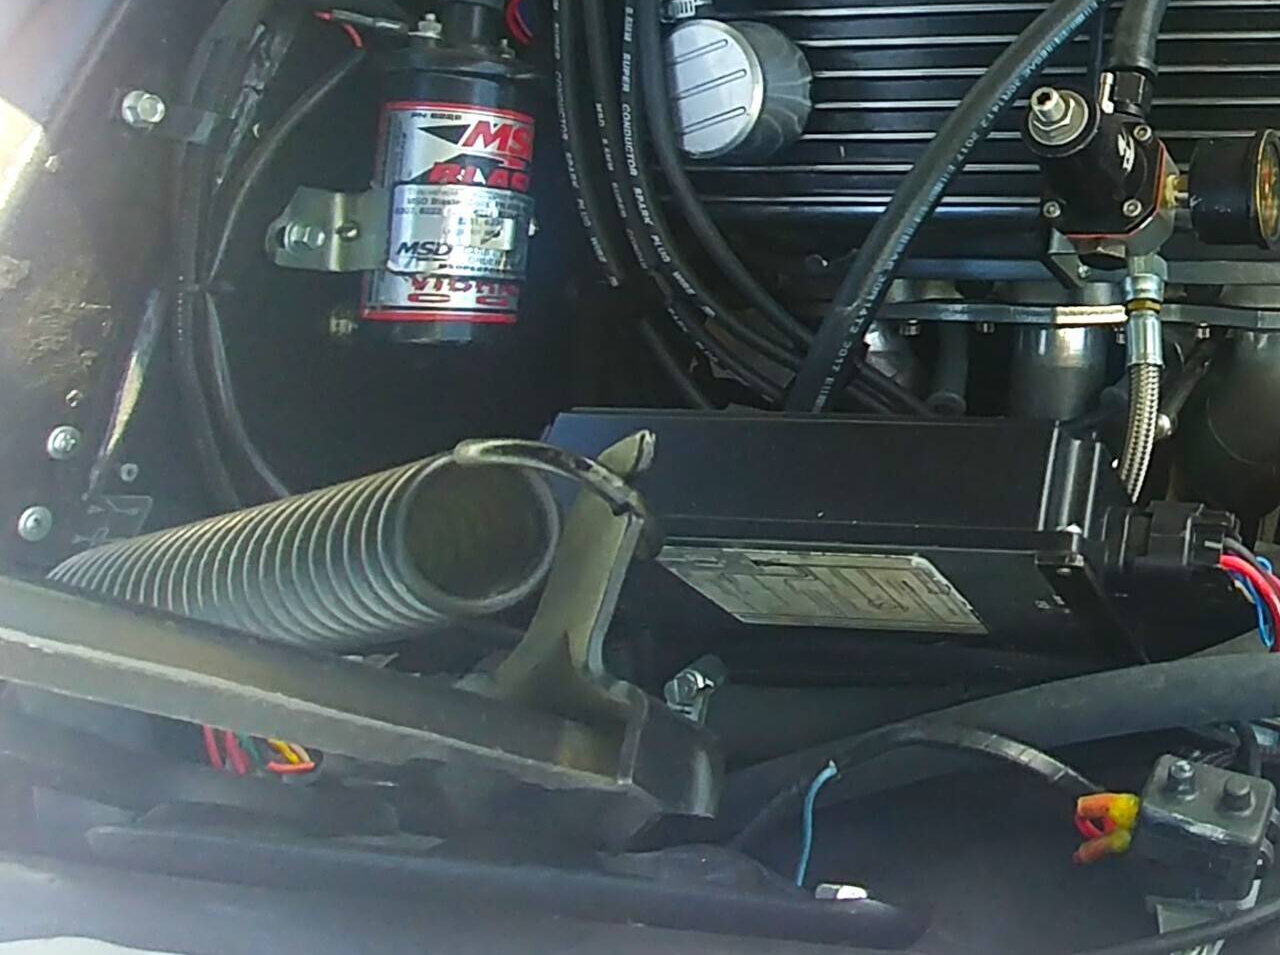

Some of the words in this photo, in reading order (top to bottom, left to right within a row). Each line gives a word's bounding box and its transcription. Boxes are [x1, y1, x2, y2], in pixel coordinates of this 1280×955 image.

[461, 120, 532, 163] MS
[621, 103, 637, 176] CONDUCTOR
[633, 186, 654, 226] SPARK
[396, 240, 453, 257] MSD
